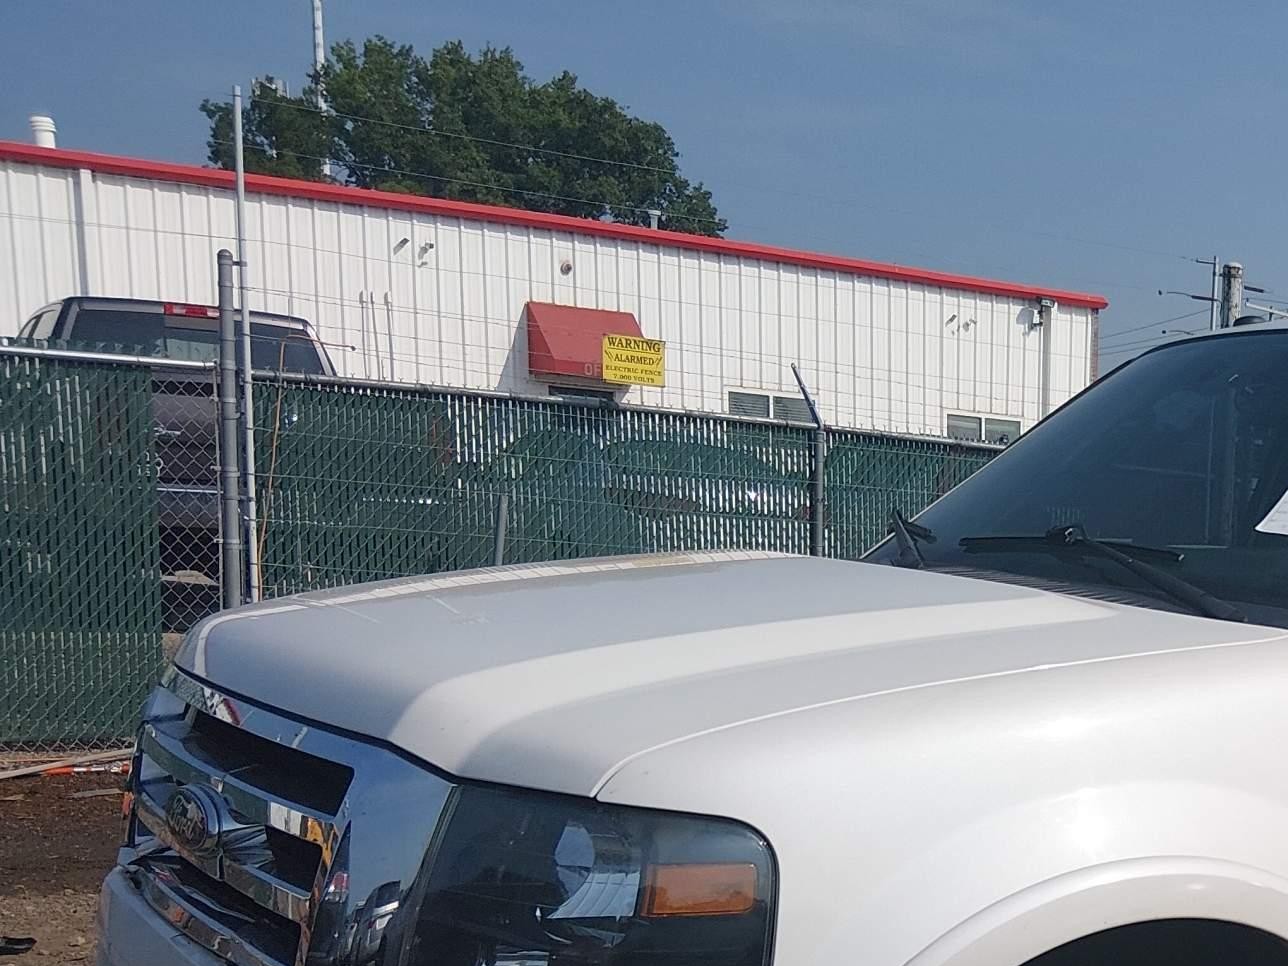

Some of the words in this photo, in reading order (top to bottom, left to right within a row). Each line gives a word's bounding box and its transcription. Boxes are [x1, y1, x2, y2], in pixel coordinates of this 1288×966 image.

[607, 336, 662, 353] WARNING
[613, 353, 655, 366] ALARMED
[605, 364, 640, 374] ELECTRIC
[640, 368, 663, 377] FENCE
[633, 375, 655, 384] VOLTS
